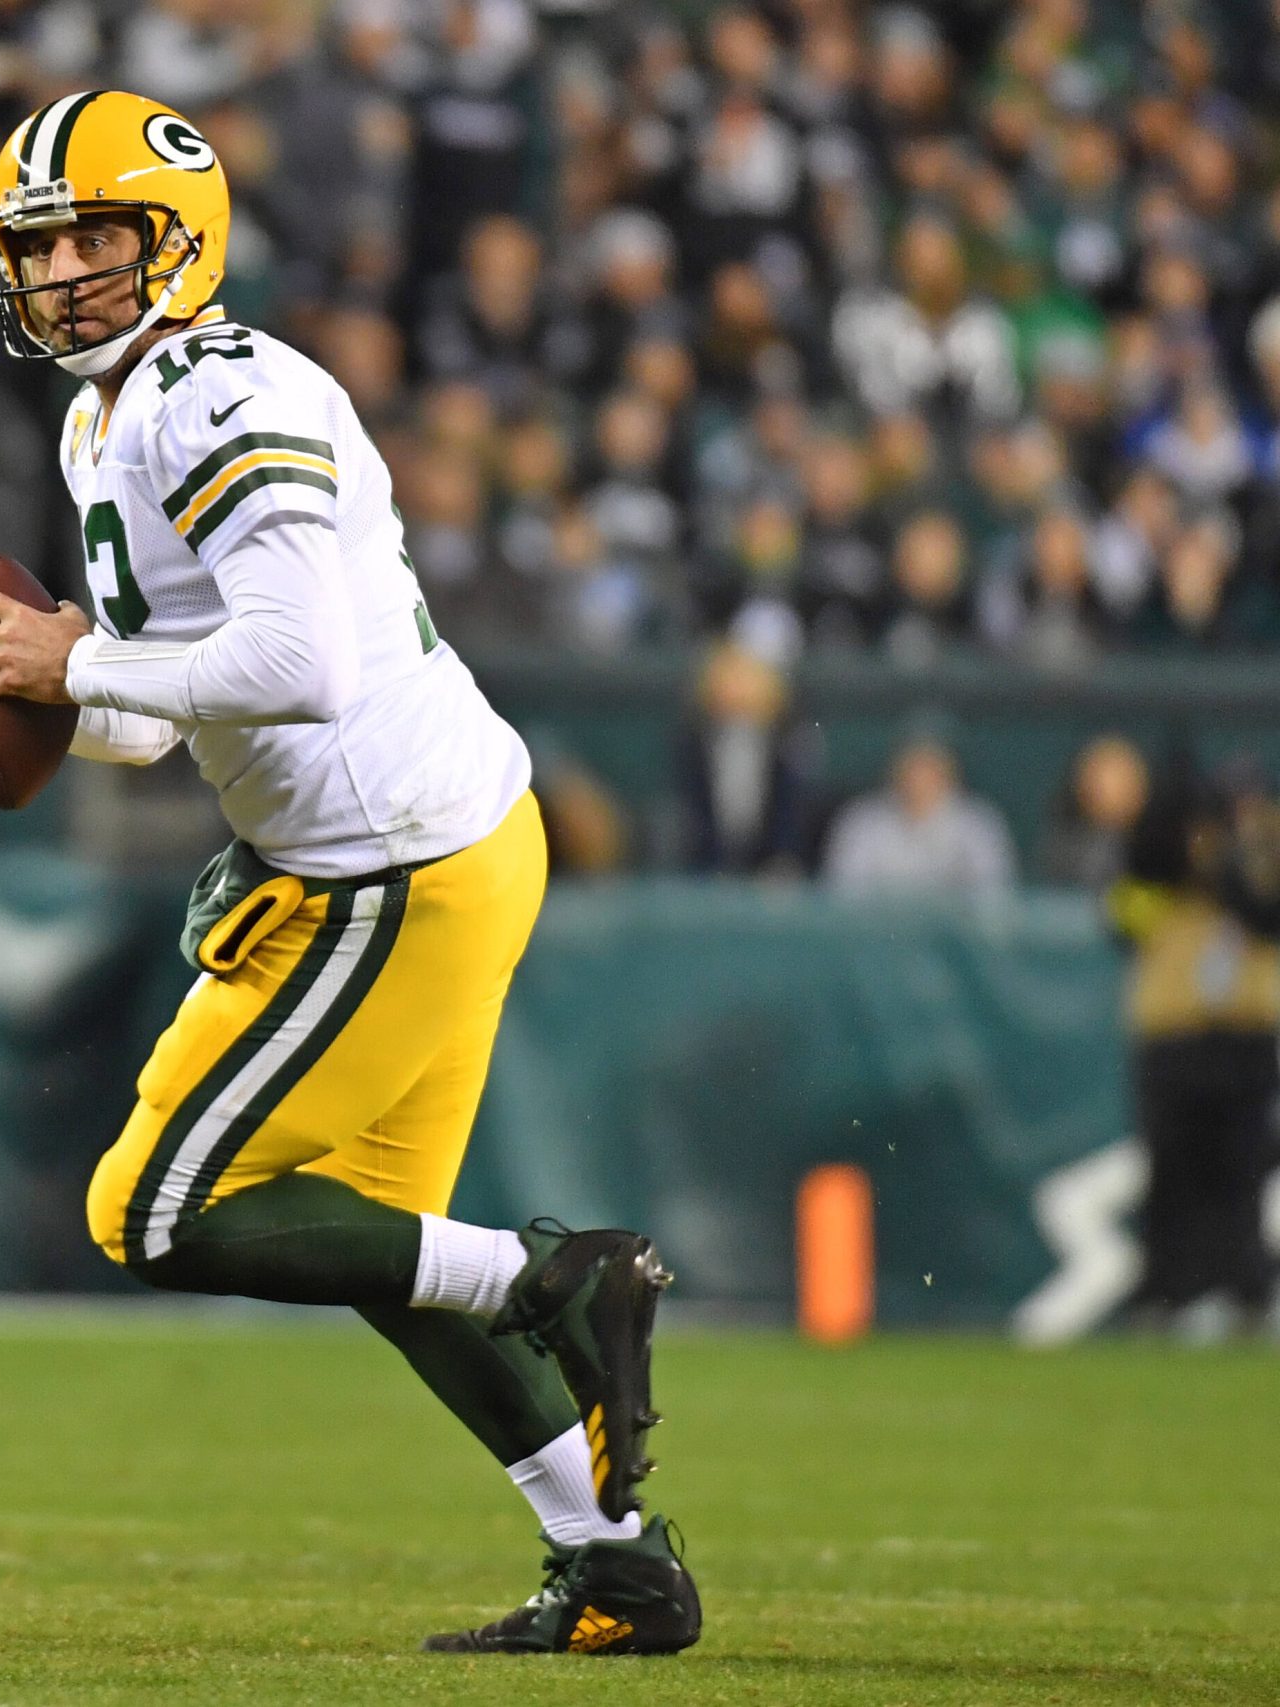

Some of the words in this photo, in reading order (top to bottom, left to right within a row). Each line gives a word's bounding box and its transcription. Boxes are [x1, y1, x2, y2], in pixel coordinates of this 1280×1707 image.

[143, 113, 215, 173] G
[24, 186, 54, 199] PACKERS
[147, 328, 254, 394] 12
[569, 1622, 633, 1653] adidas
